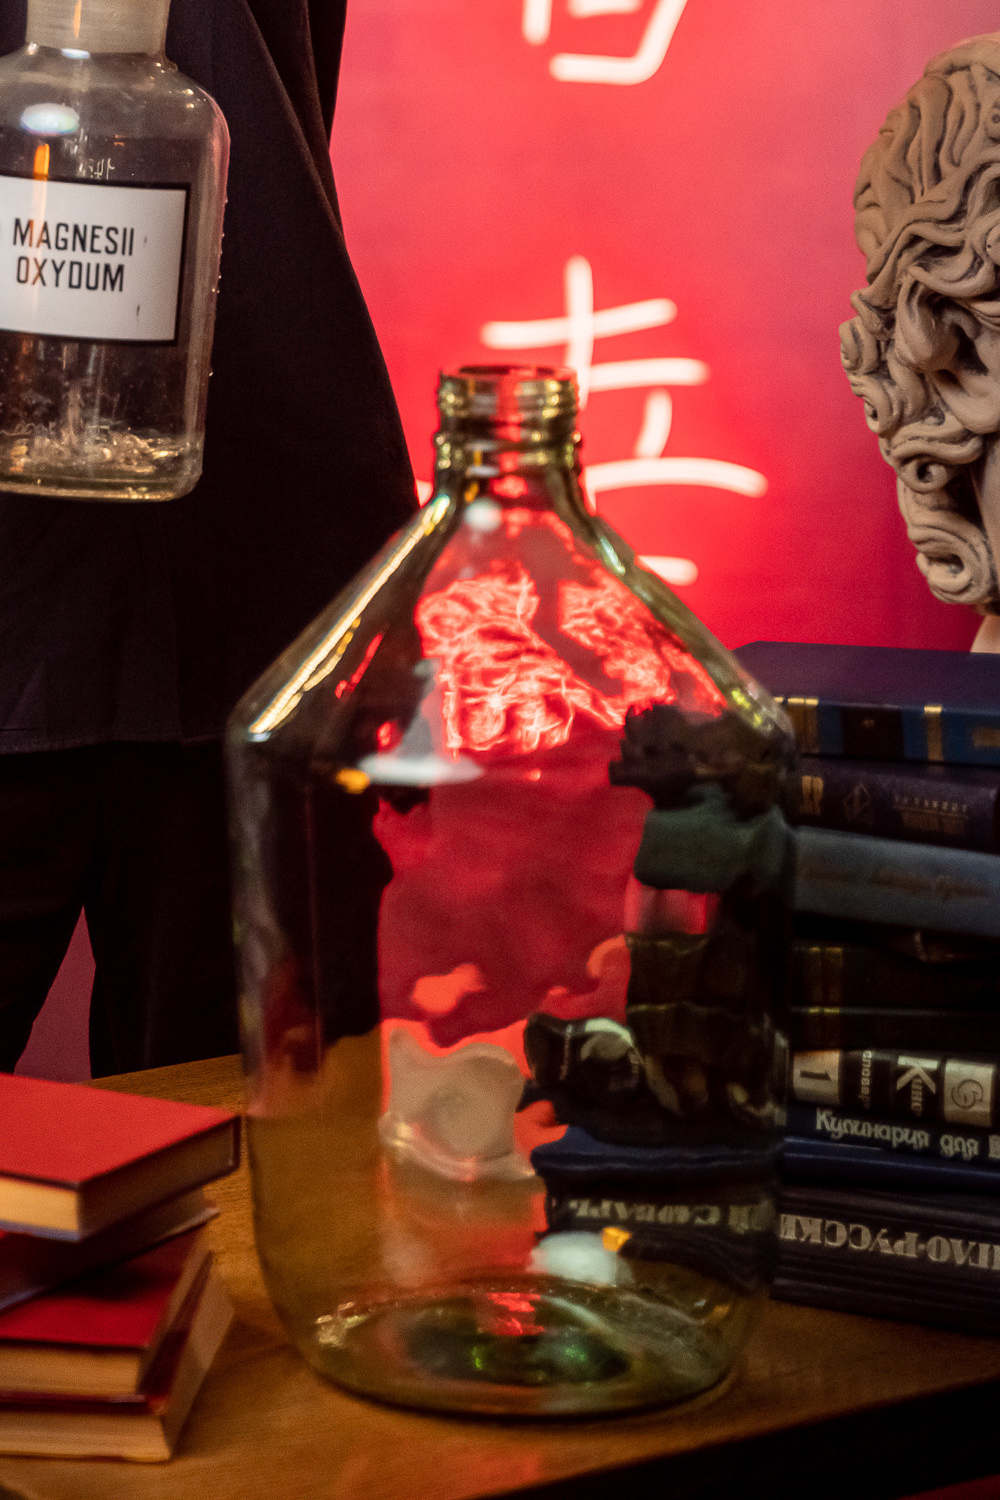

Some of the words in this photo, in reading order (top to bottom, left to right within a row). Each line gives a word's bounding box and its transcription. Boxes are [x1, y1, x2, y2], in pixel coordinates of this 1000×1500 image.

[13, 218, 135, 256] MAGNESII
[16, 256, 125, 292] OXYDUM
[816, 1107, 929, 1149] Кулинария
[940, 1134, 979, 1161] для
